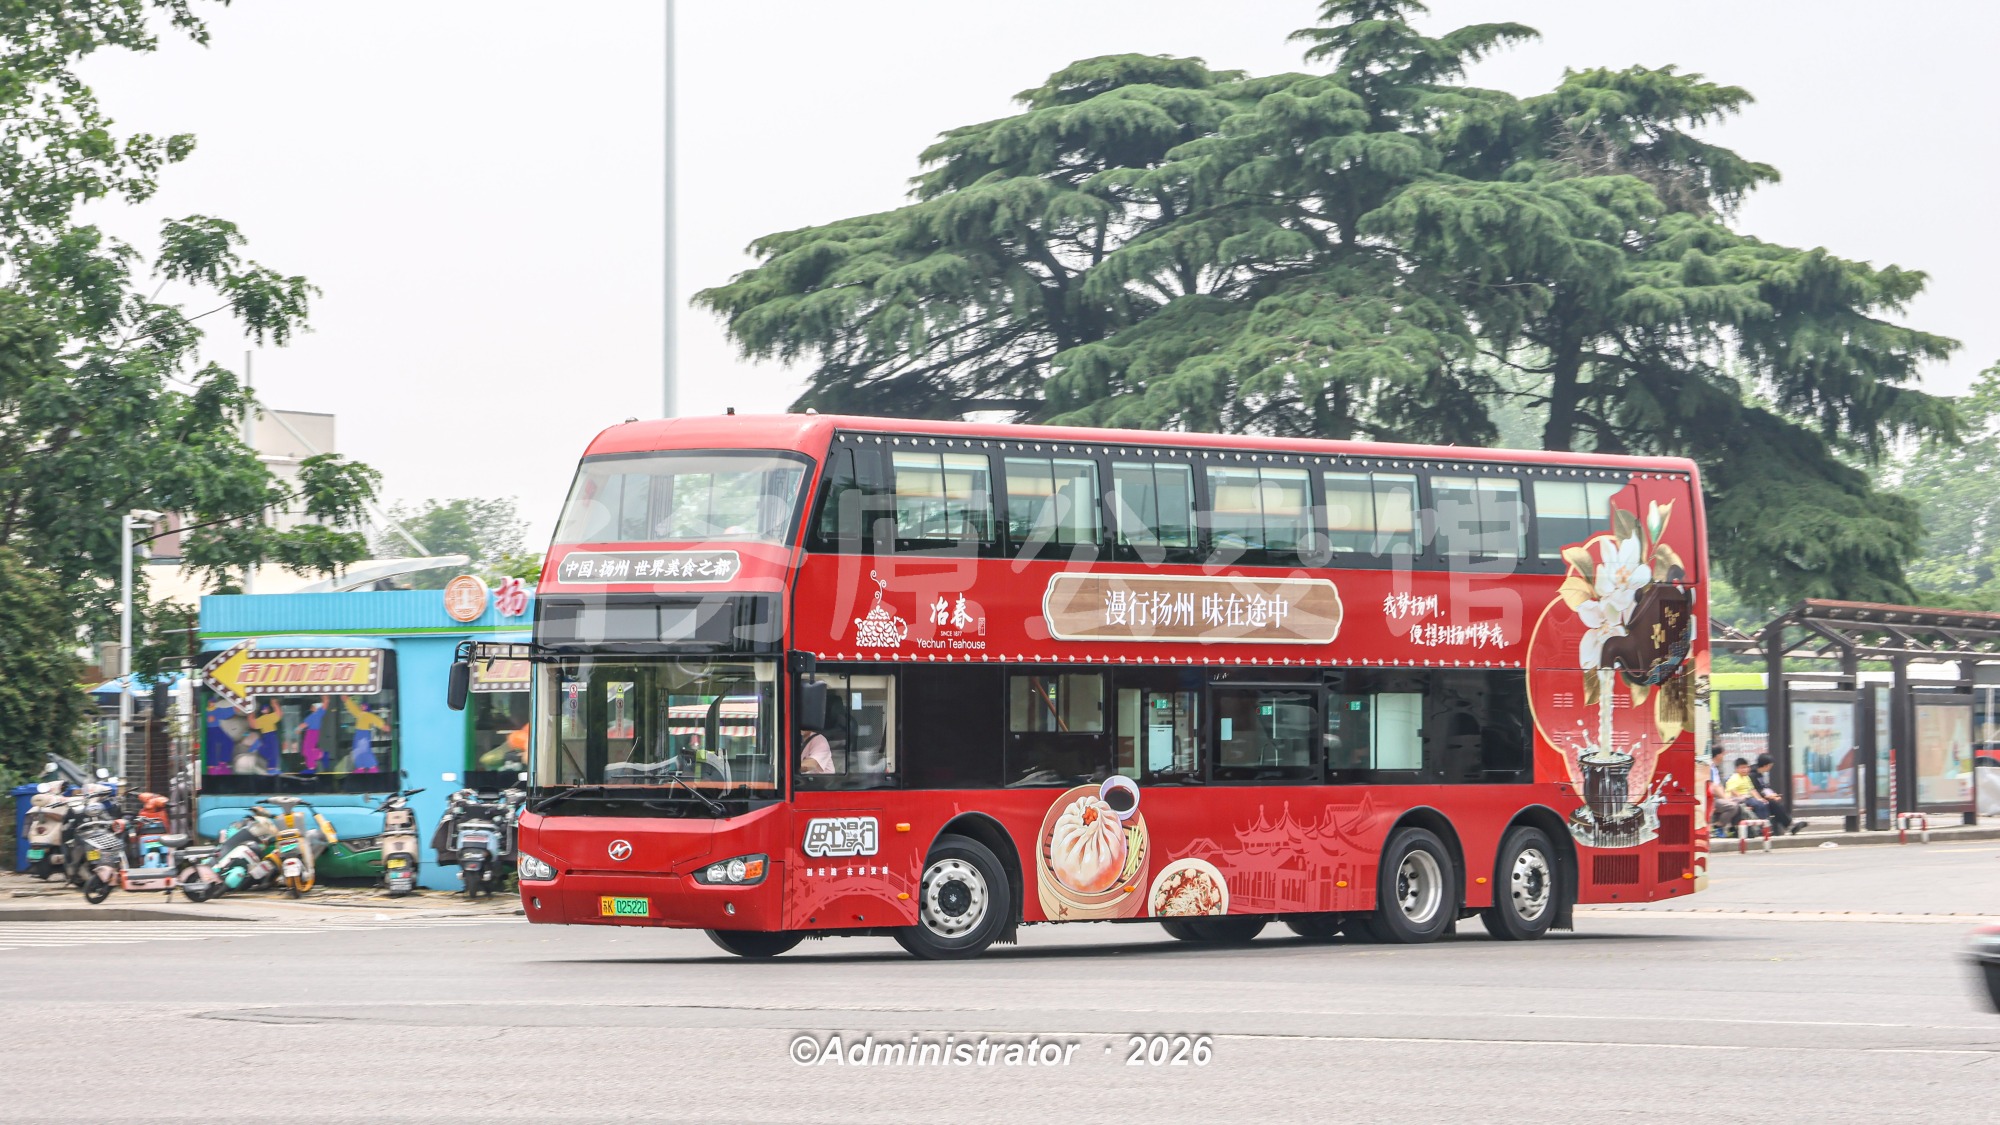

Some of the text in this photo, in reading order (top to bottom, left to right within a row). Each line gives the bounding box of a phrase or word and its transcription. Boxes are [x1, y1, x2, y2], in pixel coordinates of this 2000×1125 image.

[566, 558, 731, 578] 中国·扬州 世界美食之都
[930, 592, 973, 629] 冶春
[1105, 590, 1289, 629] 漫行扬州 味在途中
[916, 638, 986, 649] Yechun Teahouse
